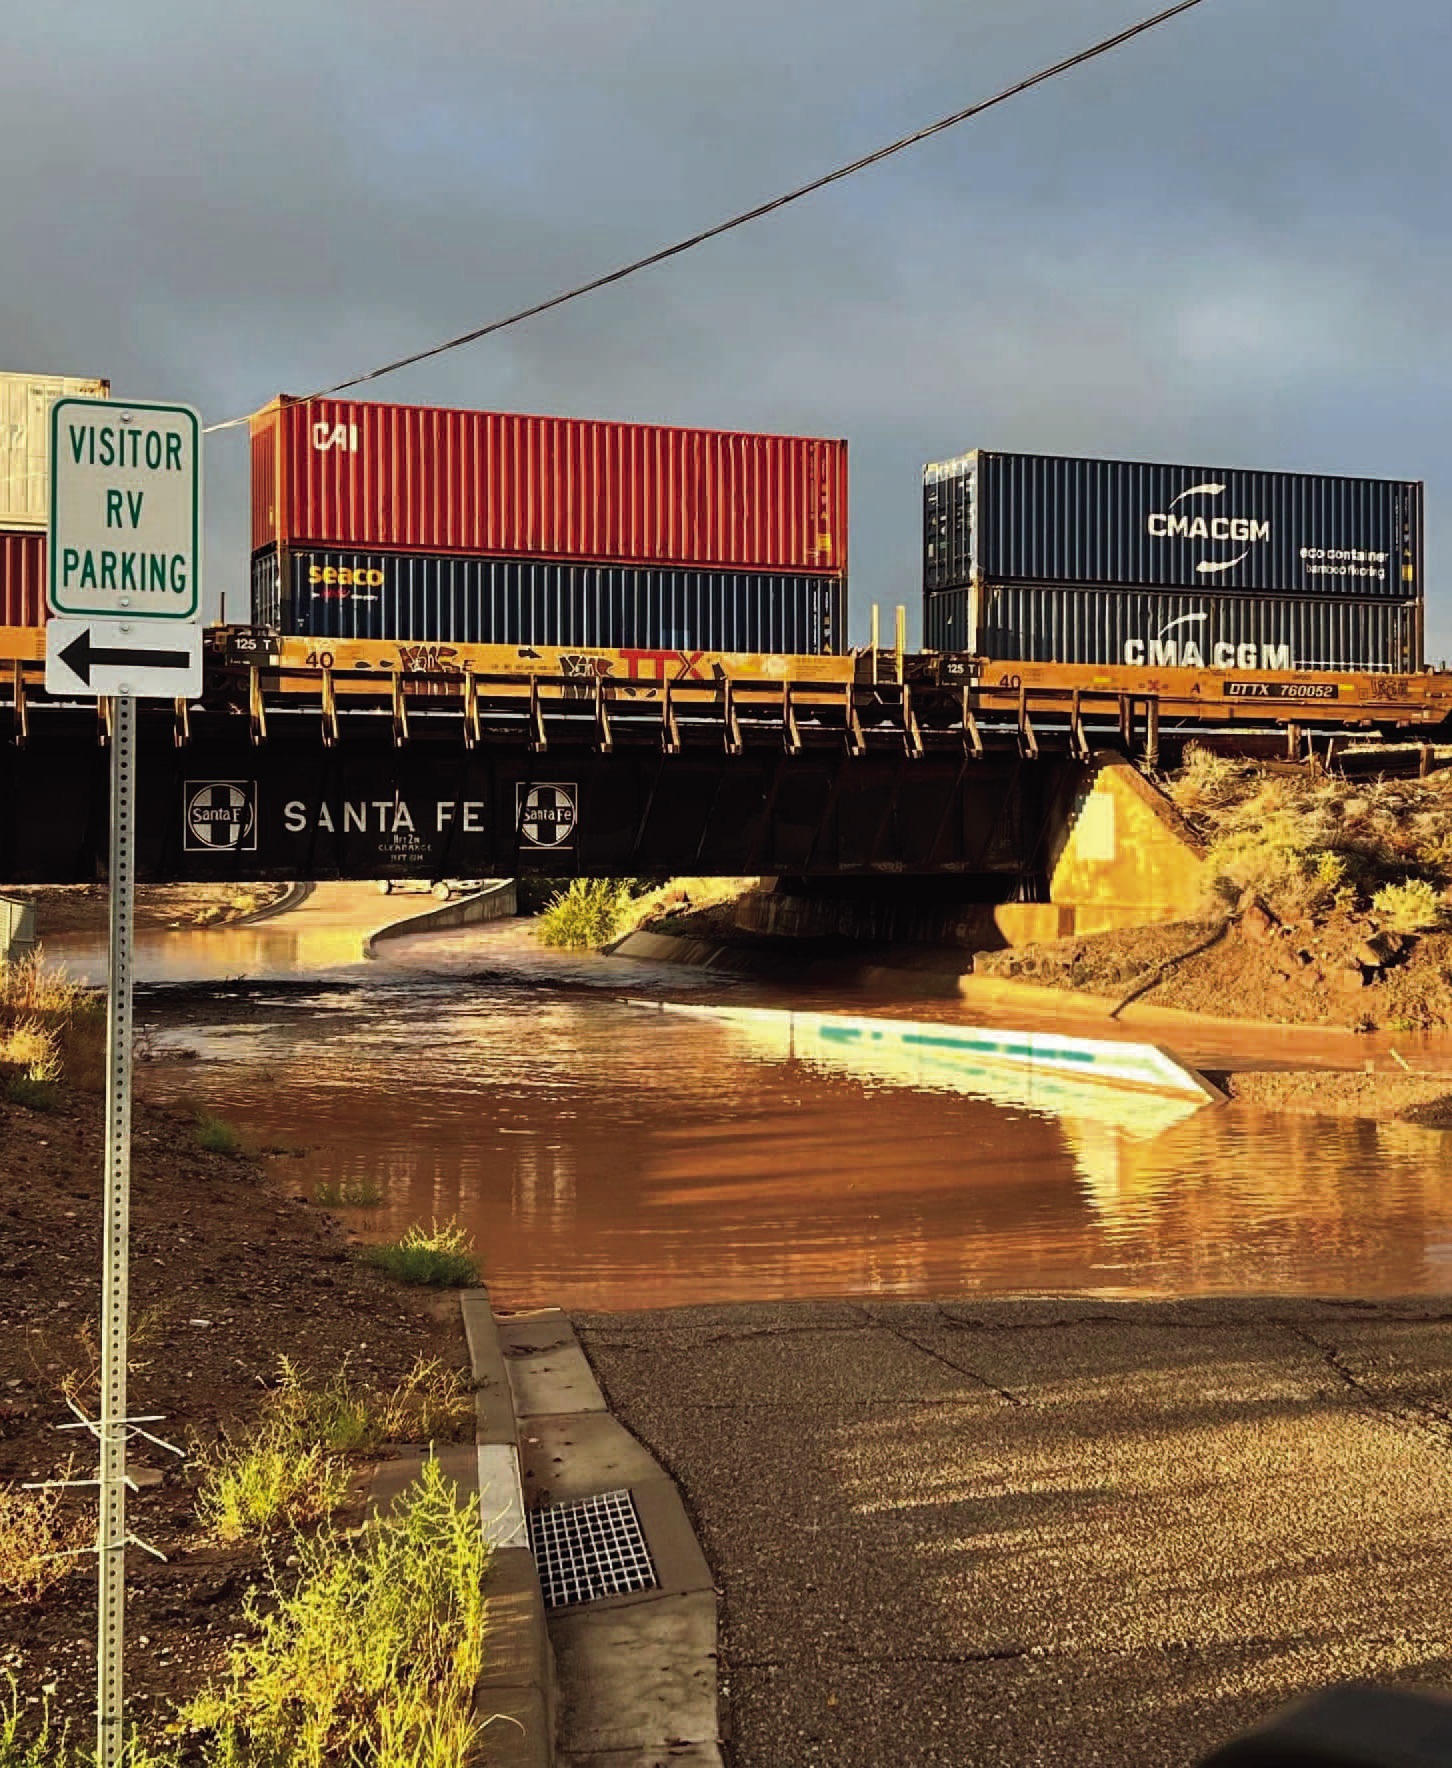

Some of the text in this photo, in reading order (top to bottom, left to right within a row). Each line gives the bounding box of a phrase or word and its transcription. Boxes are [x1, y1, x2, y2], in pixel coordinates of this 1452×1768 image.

[312, 421, 358, 452] CAI
[69, 424, 182, 471] VISITOR
[106, 489, 144, 529] RV
[1148, 513, 1270, 542] CMA CGM
[1300, 548, 1389, 562] eco container
[63, 548, 186, 594] PARKING
[308, 565, 384, 586] seaco
[234, 638, 271, 650] 125 T
[305, 651, 334, 668] 40
[619, 650, 704, 680] TTX
[1124, 639, 1290, 671] CMA CGM
[946, 664, 976, 674] 125 T
[1000, 674, 1021, 689] 40
[1229, 683, 1333, 697] DTTX 760052
[192, 808, 231, 823] Santa
[283, 801, 485, 833] SANTA FE
[523, 808, 572, 822] Santa Fe
